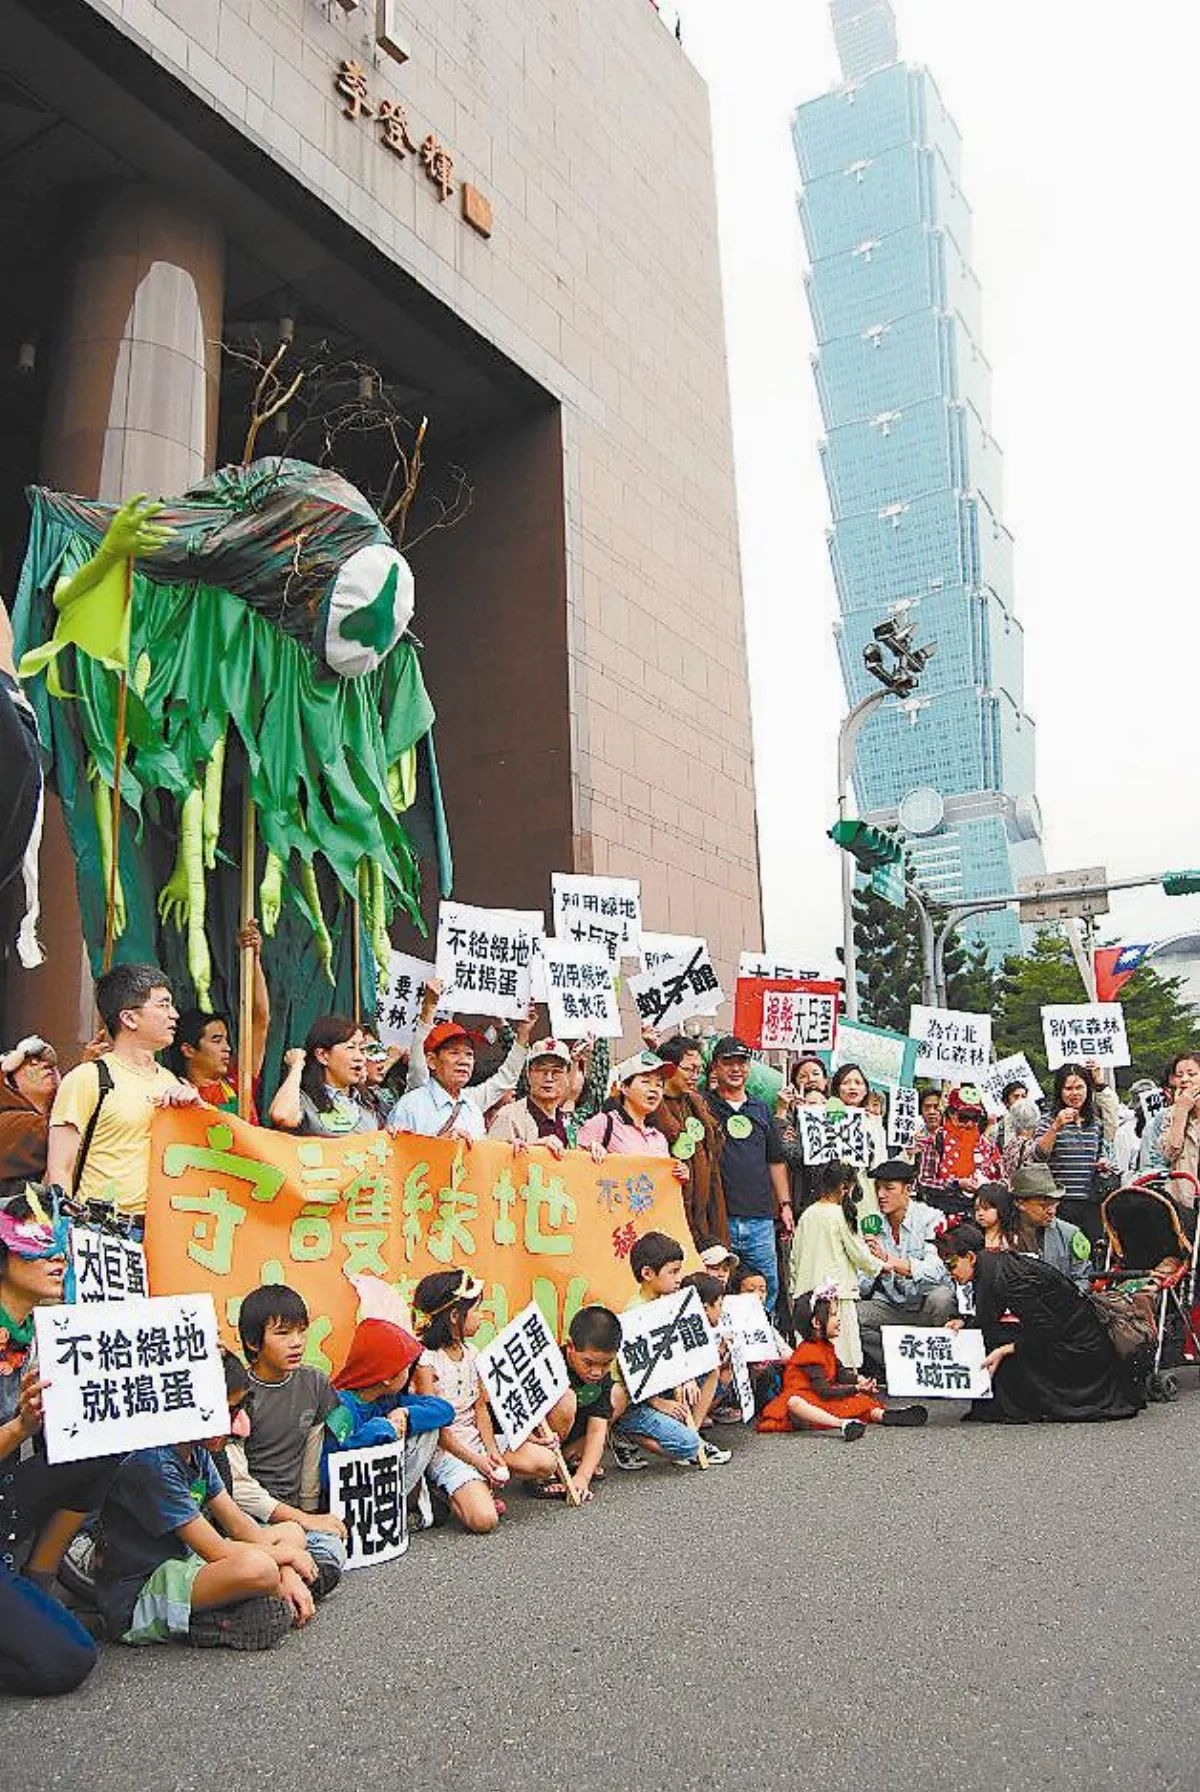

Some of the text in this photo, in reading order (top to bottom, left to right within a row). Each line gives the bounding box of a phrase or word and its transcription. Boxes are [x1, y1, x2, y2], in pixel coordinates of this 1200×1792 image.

[334, 60, 454, 203] 李登輝
[561, 893, 637, 919] 別用綠地
[446, 927, 530, 968] 不給綠地
[454, 961, 518, 997] 就搗蛋
[162, 1123, 578, 1278] 守護綠地
[77, 1239, 145, 1296] 大巨蛋
[56, 1323, 208, 1375] 不給綠地
[488, 1313, 550, 1397] 大巨蛋
[899, 1335, 954, 1361] 永續
[80, 1370, 196, 1423] 就搗蛋
[916, 1362, 971, 1389] 城市
